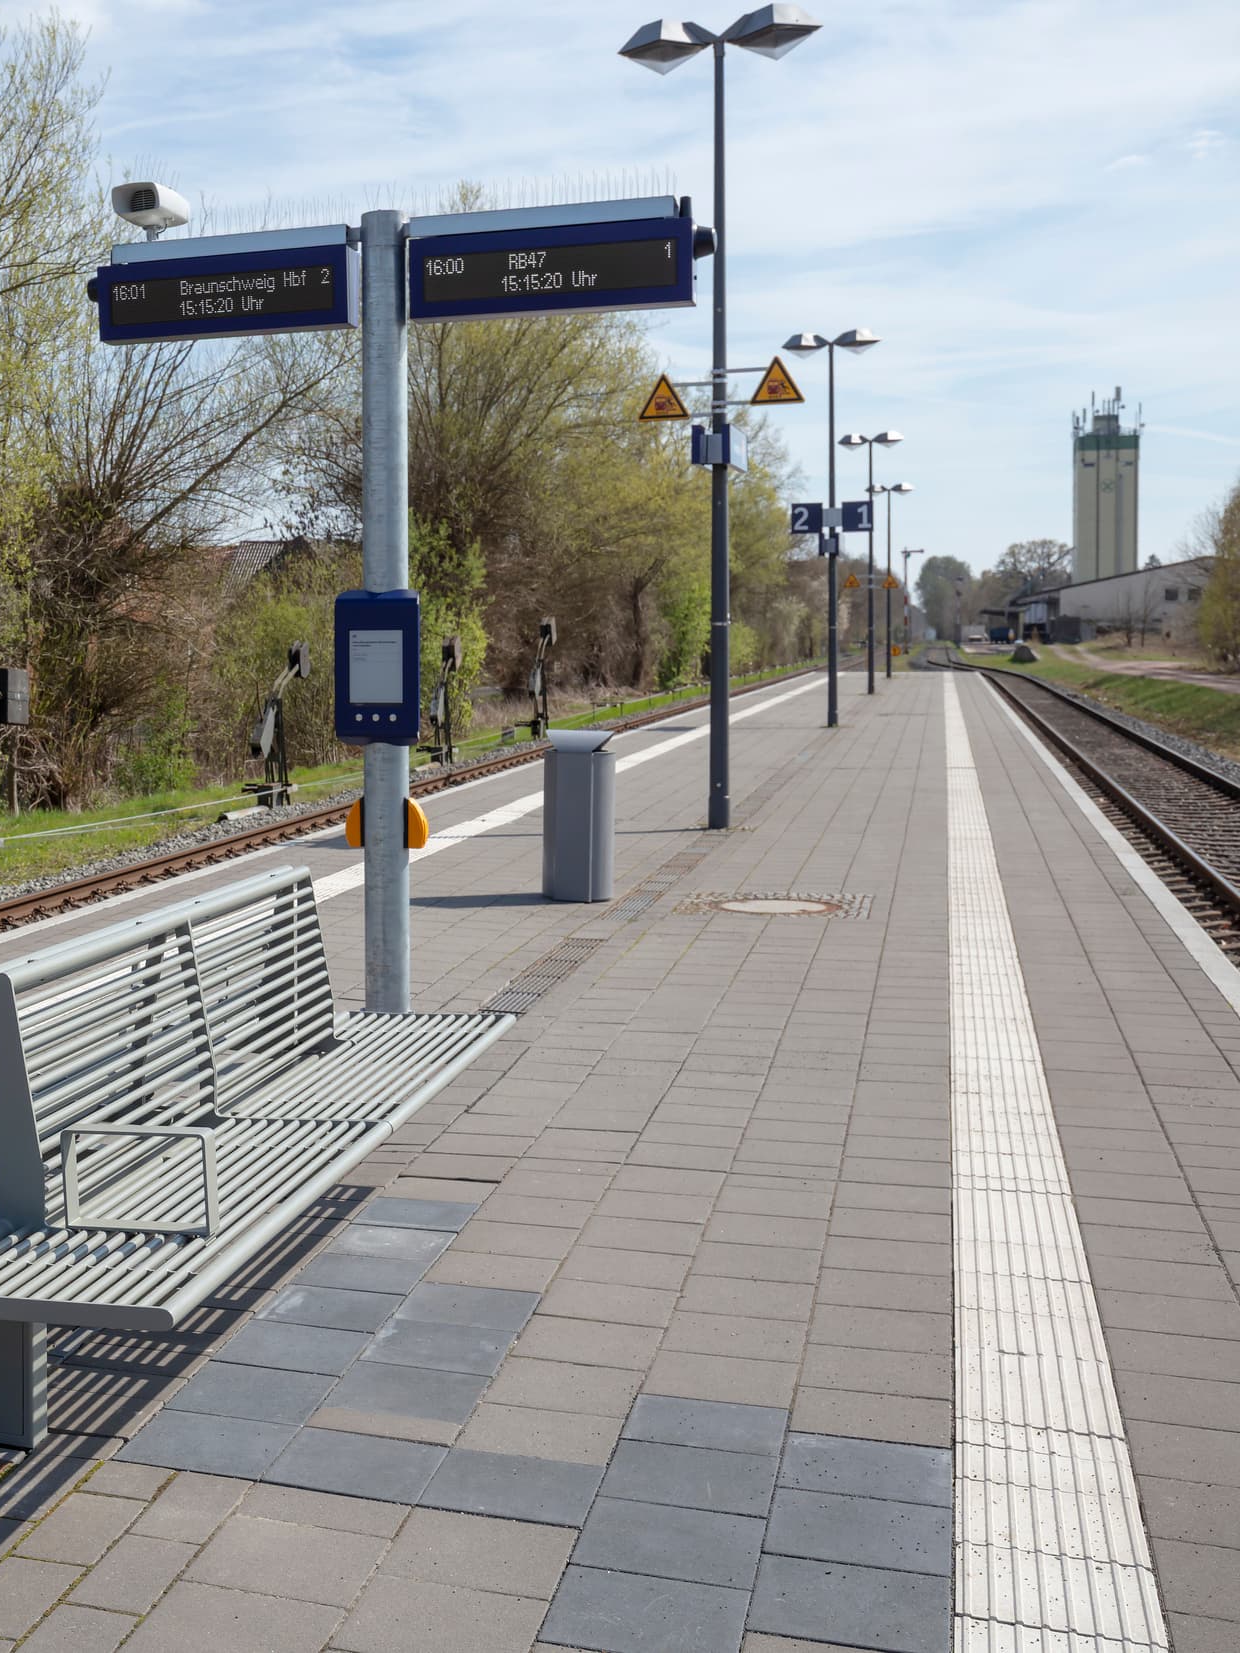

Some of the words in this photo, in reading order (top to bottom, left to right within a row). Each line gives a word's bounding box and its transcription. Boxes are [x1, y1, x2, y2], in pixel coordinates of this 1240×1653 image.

[426, 257, 465, 276] 16:00
[508, 251, 547, 270] RB47
[664, 241, 671, 258] 1
[112, 283, 146, 302] 16:01
[180, 274, 275, 296] Braunschweig
[283, 270, 307, 287] Hbf
[320, 268, 330, 284] 2
[501, 272, 563, 292] 15:15:20
[571, 270, 598, 288] Uhr
[179, 297, 234, 316] 15:15:20
[241, 295, 264, 312] Uhr
[793, 507, 809, 531] 2
[857, 505, 872, 529] 1
